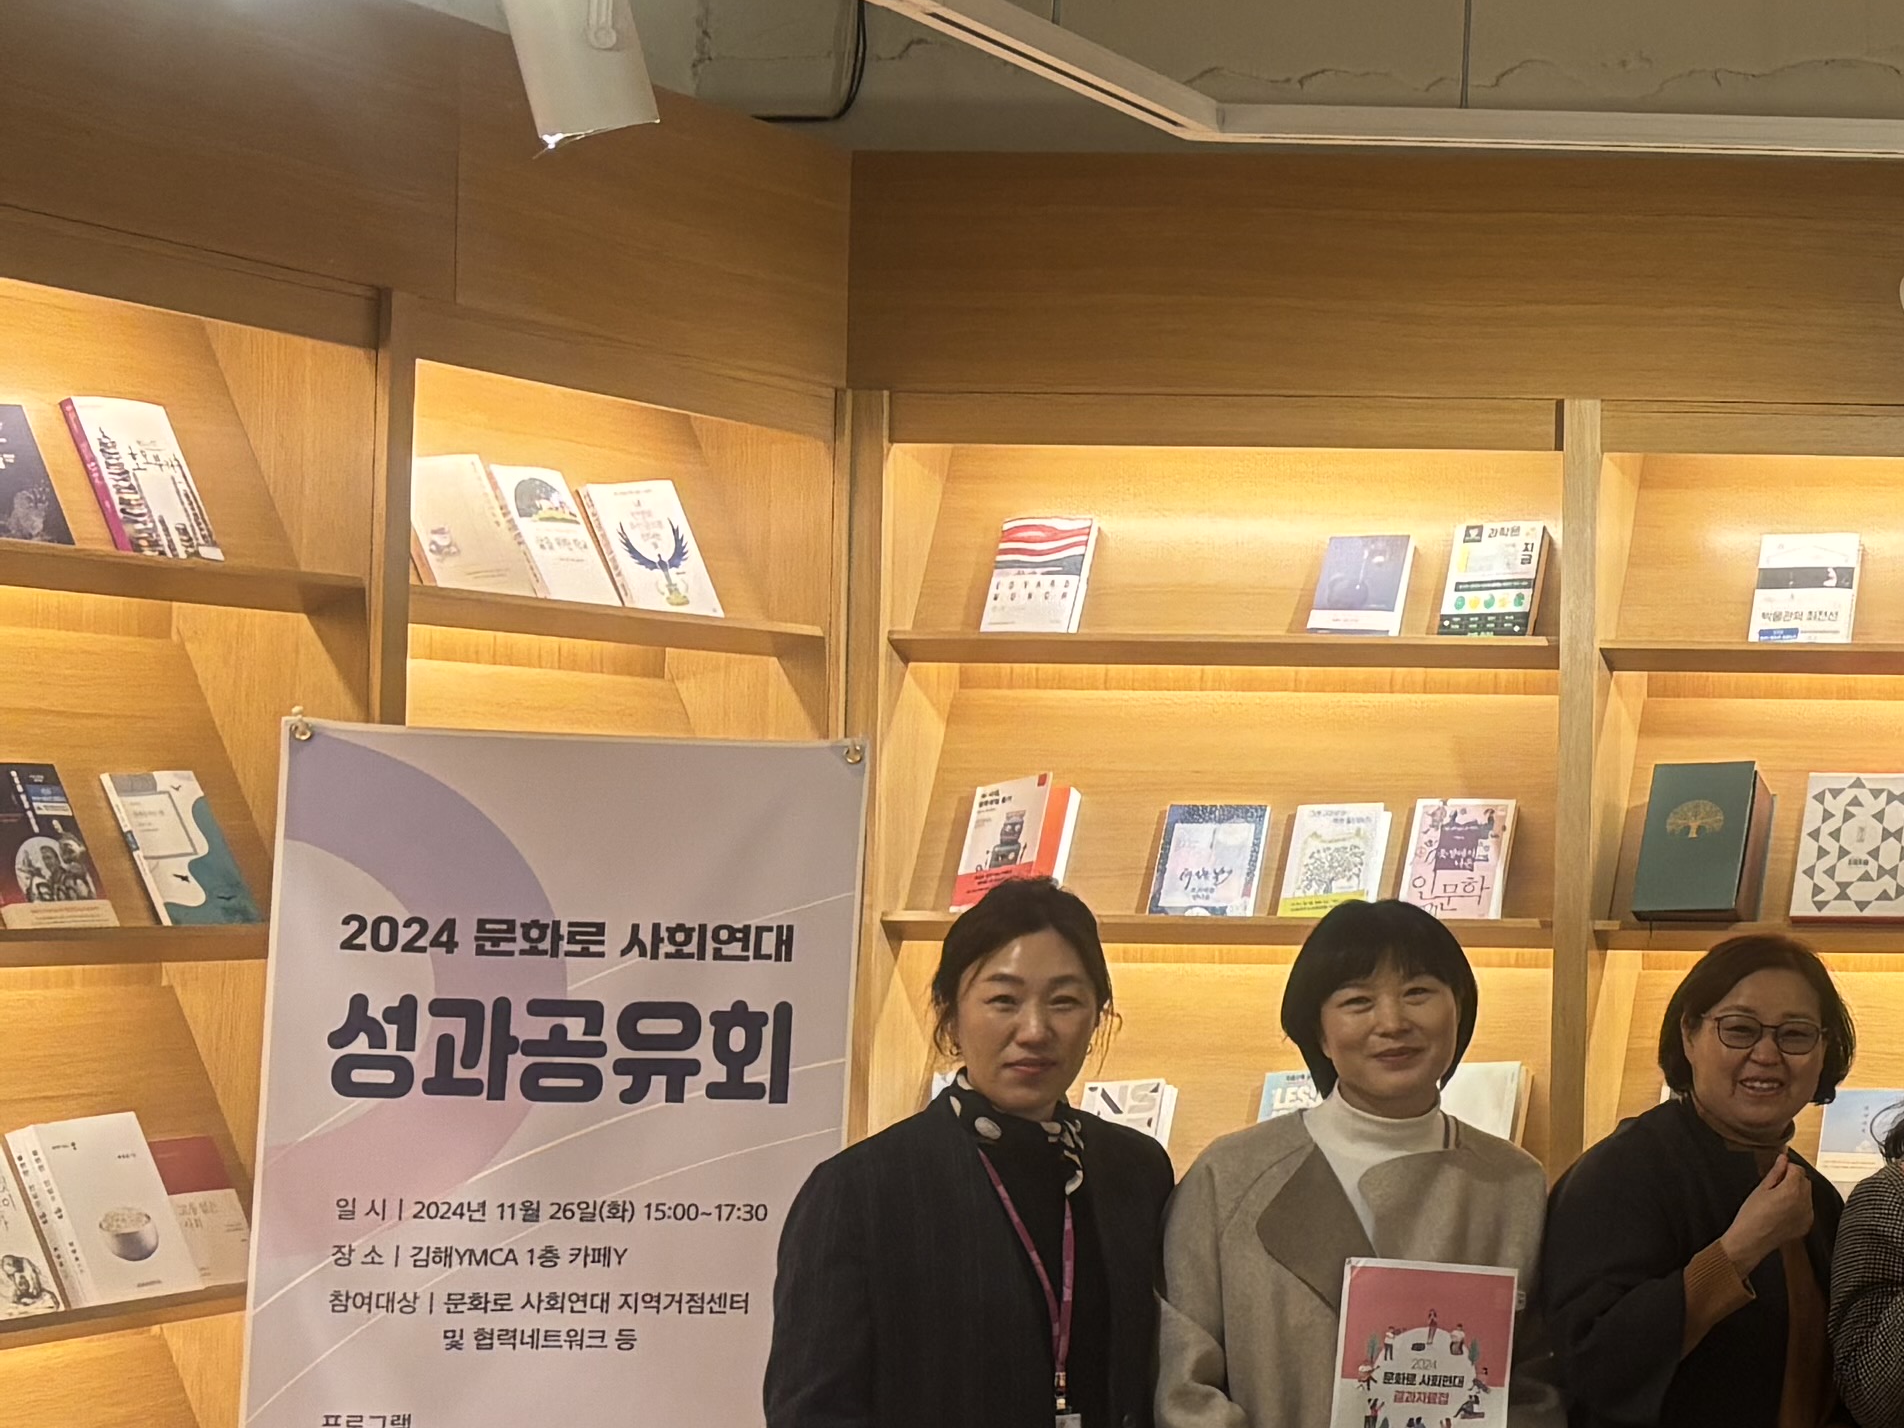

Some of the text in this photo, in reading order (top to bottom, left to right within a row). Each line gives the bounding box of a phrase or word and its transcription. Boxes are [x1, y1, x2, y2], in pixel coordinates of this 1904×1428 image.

[340, 915, 794, 963] 2024 문화로 사회연대
[327, 993, 793, 1104] 성과공유회
[412, 1200, 488, 1222] 2024년
[495, 1200, 541, 1223] 11월
[549, 1200, 635, 1224] 26일(화)
[643, 1204, 768, 1222] 15:00~17:30
[409, 1245, 518, 1269] 김해YMCA
[526, 1245, 559, 1269] 1층
[567, 1245, 628, 1269] 카페Y
[328, 1290, 749, 1315] 참여대상 문화로 사회연대 지역거점센터
[442, 1327, 637, 1352] 및 협력네트워크 등
[1411, 1358, 1437, 1370] 2024
